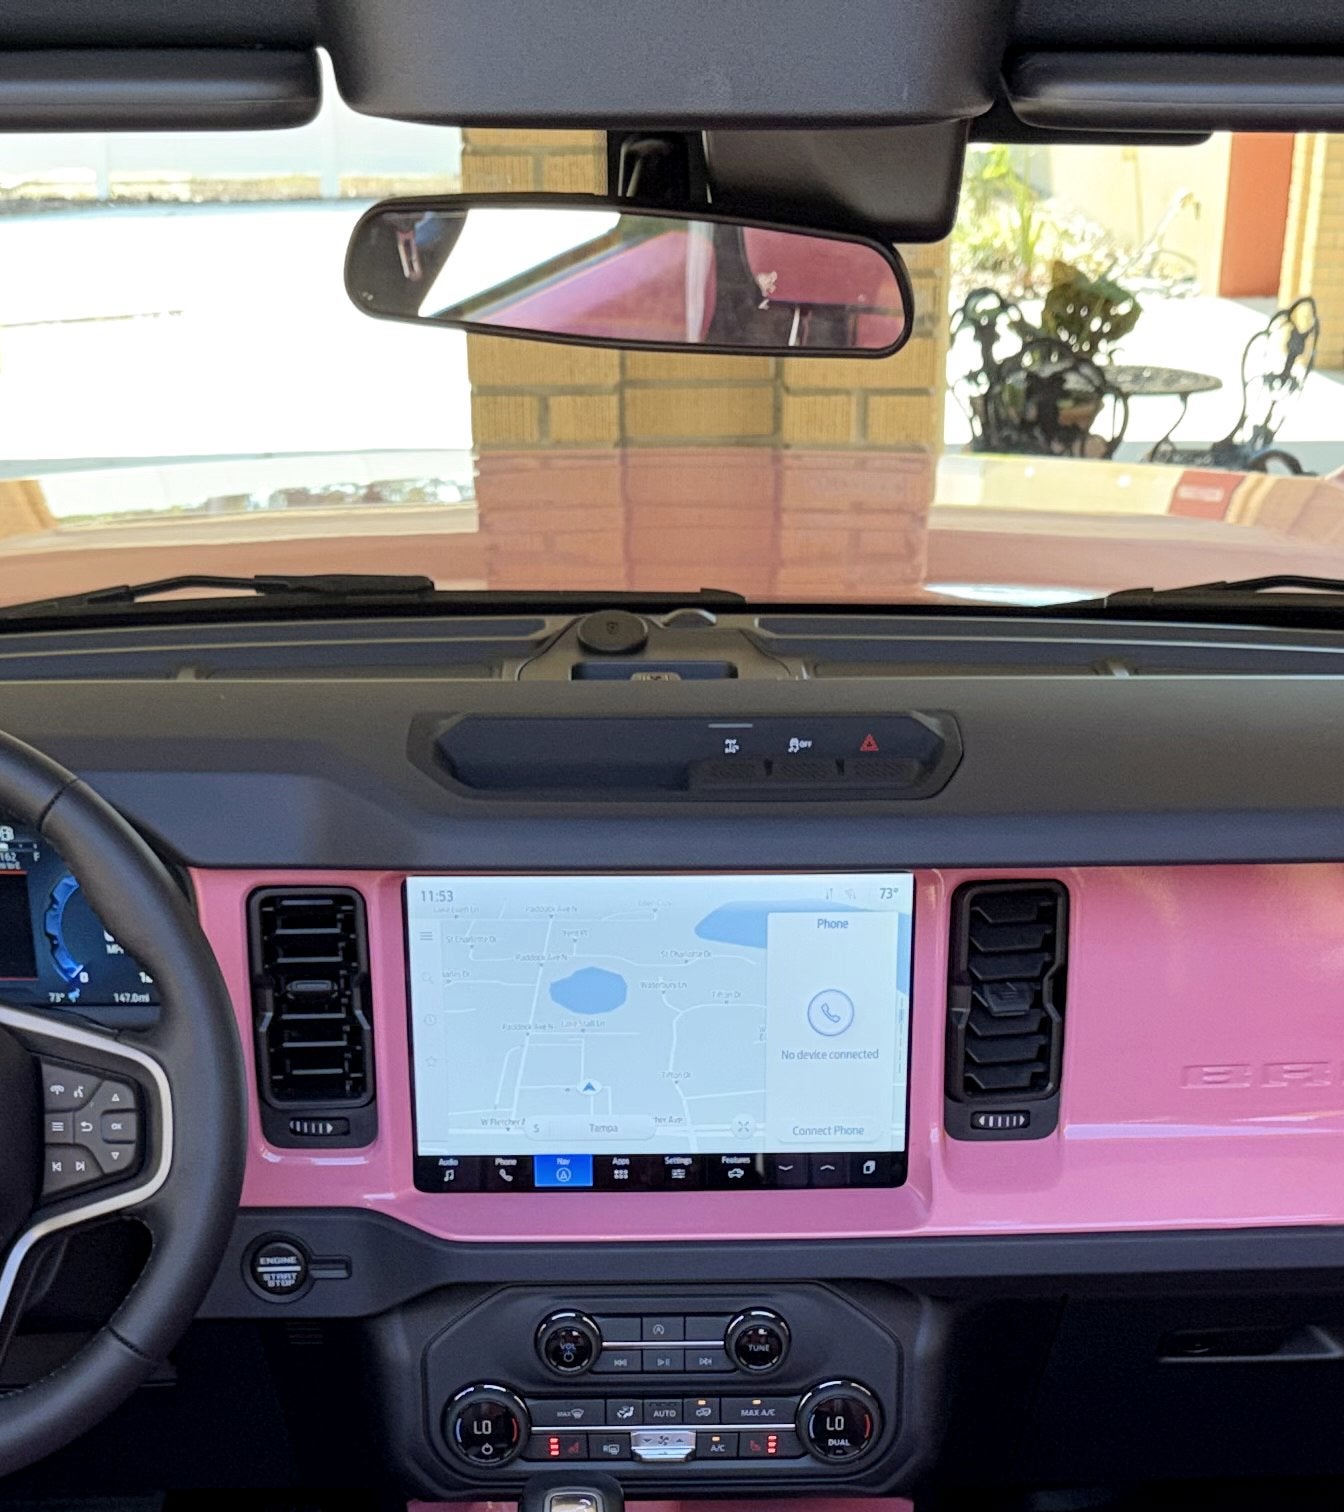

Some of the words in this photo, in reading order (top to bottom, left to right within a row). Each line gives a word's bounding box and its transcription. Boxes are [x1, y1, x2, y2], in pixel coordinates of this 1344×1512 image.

[799, 740, 812, 748] OFF
[34, 852, 40, 861] F
[420, 890, 454, 903] 11:53
[879, 888, 899, 900] 73°
[817, 918, 849, 930] Phone
[106, 944, 124, 954] MP
[79, 971, 89, 983] 0
[781, 1050, 796, 1060] No
[797, 1049, 827, 1060] device
[828, 1049, 879, 1060] connected
[533, 1124, 540, 1133] S
[588, 1123, 618, 1135] Tampa
[792, 1126, 831, 1136] Connect
[833, 1126, 865, 1136] Phone
[438, 1158, 459, 1167] Audio
[495, 1157, 517, 1166] Phone
[556, 1157, 571, 1166] Nav
[612, 1157, 630, 1167] Apps
[664, 1156, 693, 1167] Settings
[721, 1156, 751, 1165] Features
[259, 1256, 298, 1265] ENGINE
[263, 1272, 298, 1281] START
[267, 1279, 296, 1288] STOP
[748, 1344, 770, 1352] TUNE
[653, 1409, 677, 1418] AUTO
[741, 1409, 759, 1417] MAX
[760, 1408, 776, 1417] A/C
[473, 1420, 492, 1435] LO
[826, 1415, 845, 1431] LO
[827, 1439, 850, 1447] DUAL
[710, 1444, 725, 1452] A/C
